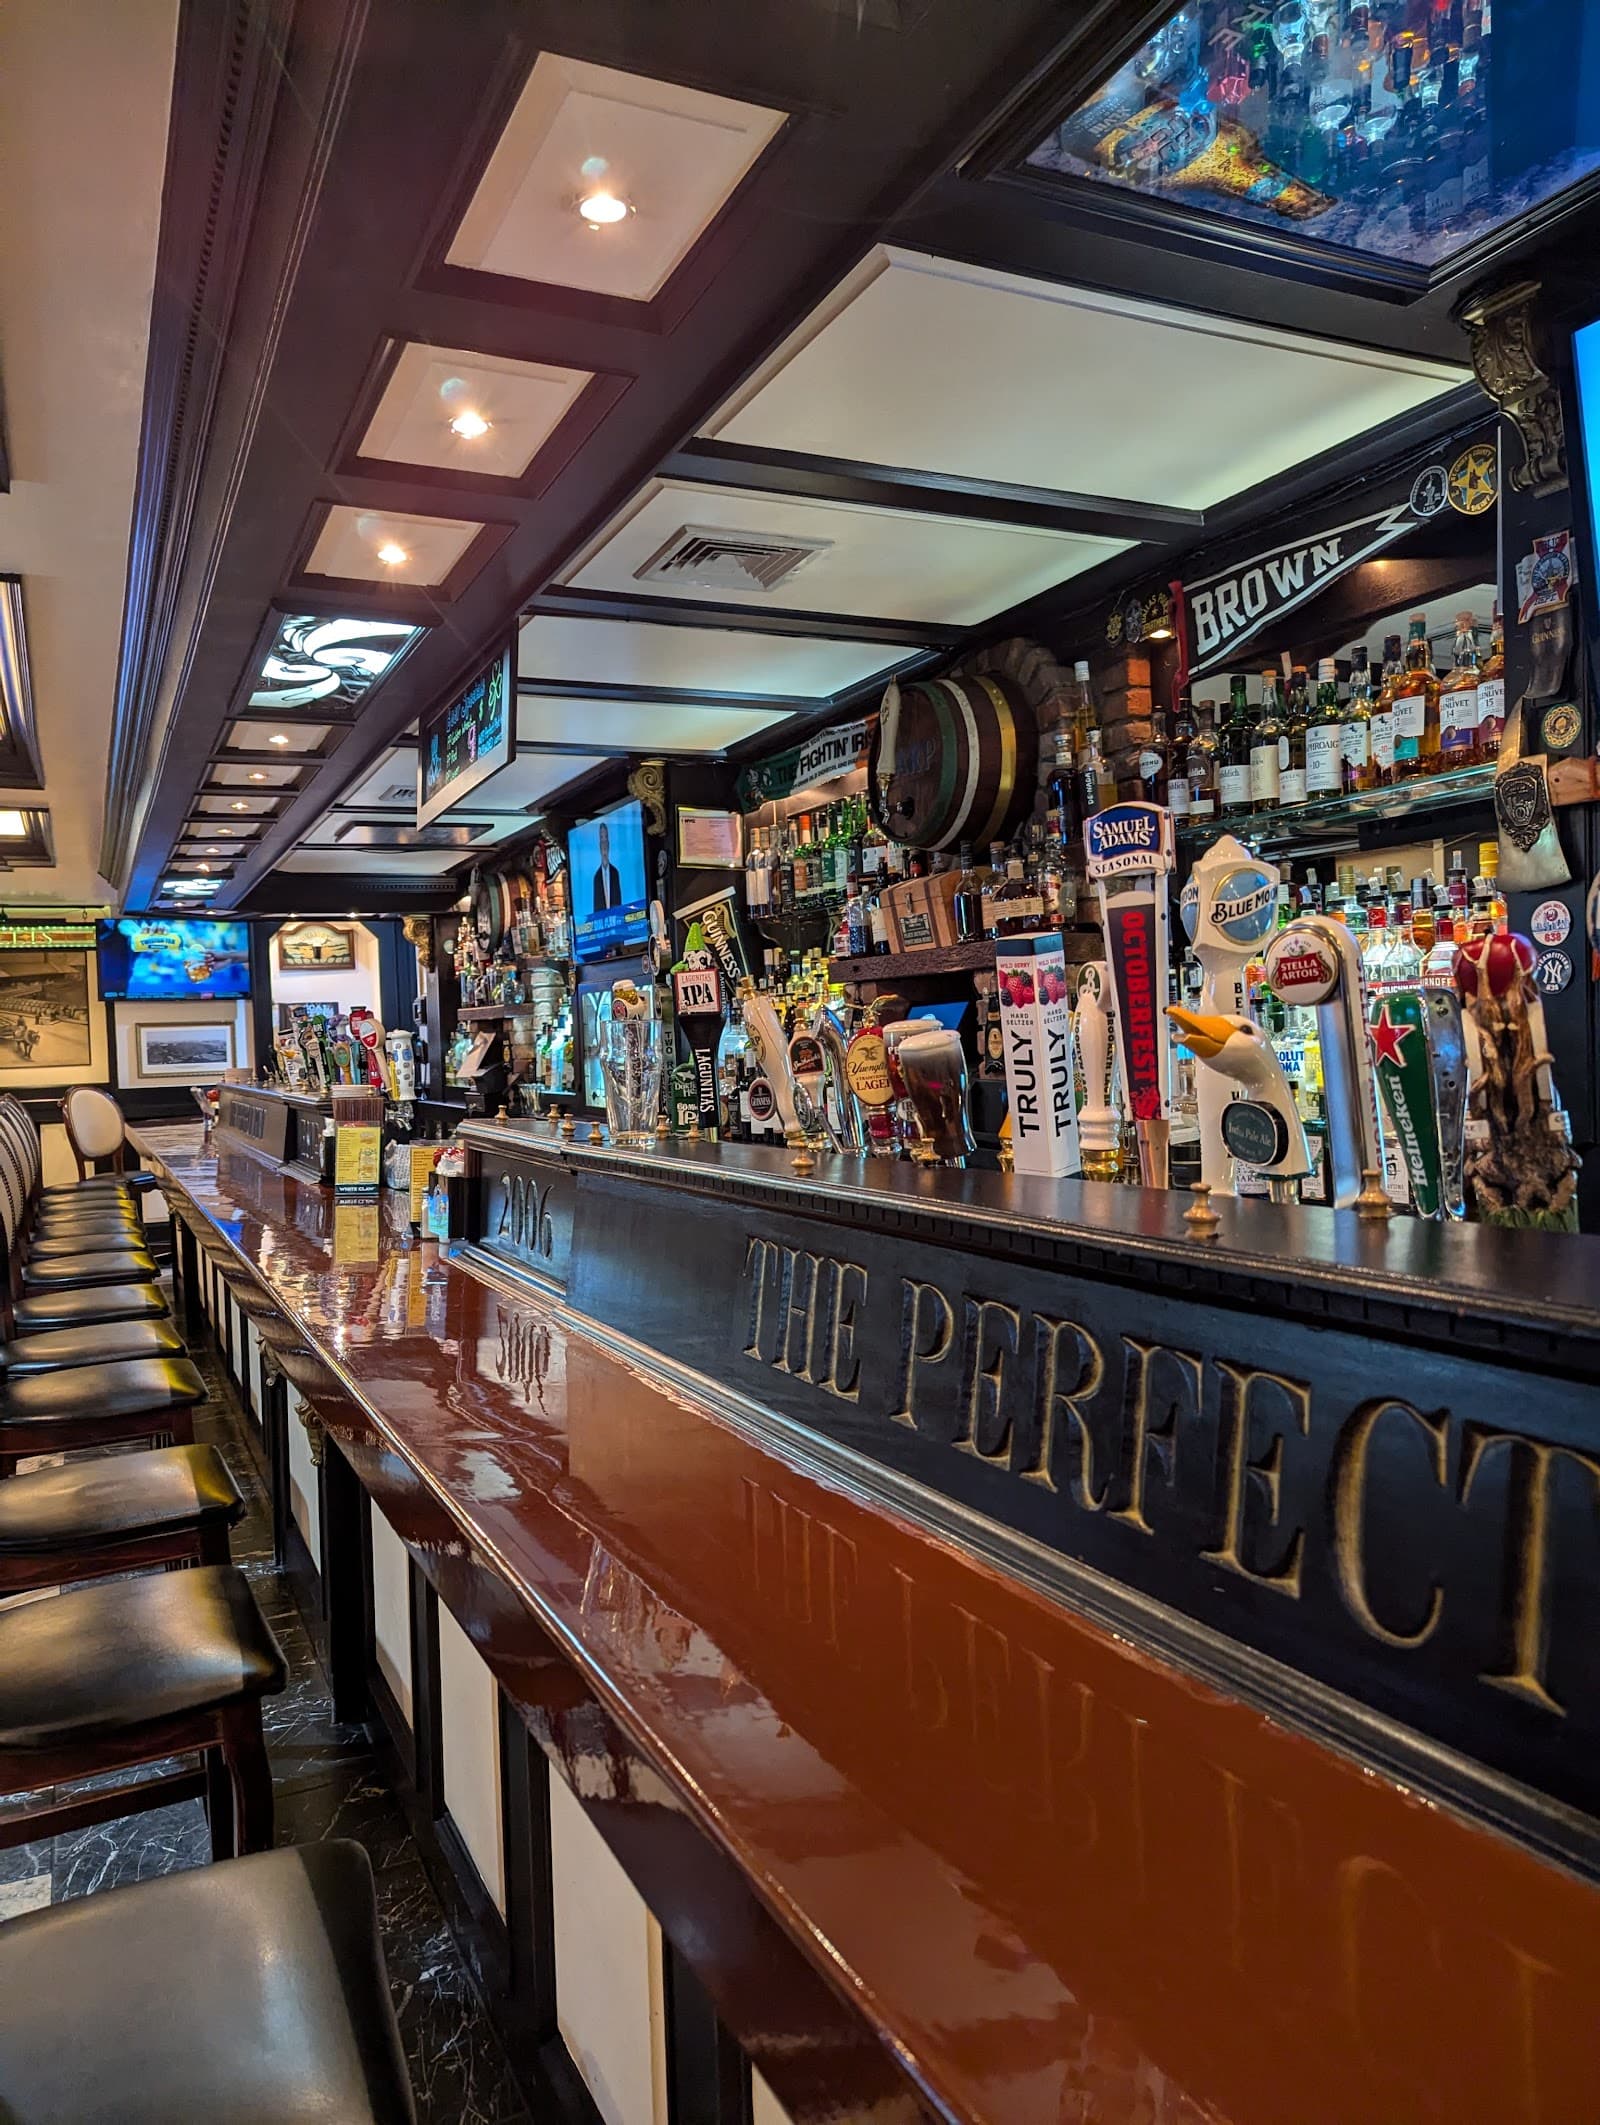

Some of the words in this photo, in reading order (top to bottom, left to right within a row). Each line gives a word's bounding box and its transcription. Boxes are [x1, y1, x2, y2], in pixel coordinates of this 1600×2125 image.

[1190, 538, 1343, 656] BROWN
[1485, 698, 1494, 708] 15
[799, 736, 849, 777] FIGHTIN'
[1312, 760, 1320, 769] 10
[1093, 816, 1155, 839] SAMUEL
[1098, 831, 1151, 852] ADAMS
[1211, 898, 1253, 923] BLUE
[702, 910, 741, 978] GUINNESS
[1280, 959, 1318, 972] STELLA
[1281, 968, 1320, 981] ARTOIS
[681, 974, 712, 984] LAGUNITAS
[681, 983, 714, 1007] IPA
[1121, 911, 1157, 1087] OCTOBERFEST
[1043, 1014, 1066, 1025] SELTZER
[1047, 1008, 1063, 1016] HARD
[664, 1031, 673, 1055] TWO
[1105, 1011, 1116, 1070] BROOKLYN
[694, 1048, 715, 1113] LAGUNITAS
[1011, 1030, 1040, 1138] TRULY
[1047, 1028, 1072, 1138] TRULY
[1228, 1121, 1244, 1137] India
[1245, 1127, 1259, 1143] Pale
[1259, 1132, 1272, 1147] Ale
[1391, 1073, 1429, 1187] Heineken
[497, 1169, 554, 1259] 2006
[742, 1233, 868, 1405] THE
[889, 1275, 1600, 1718] PERFECT
